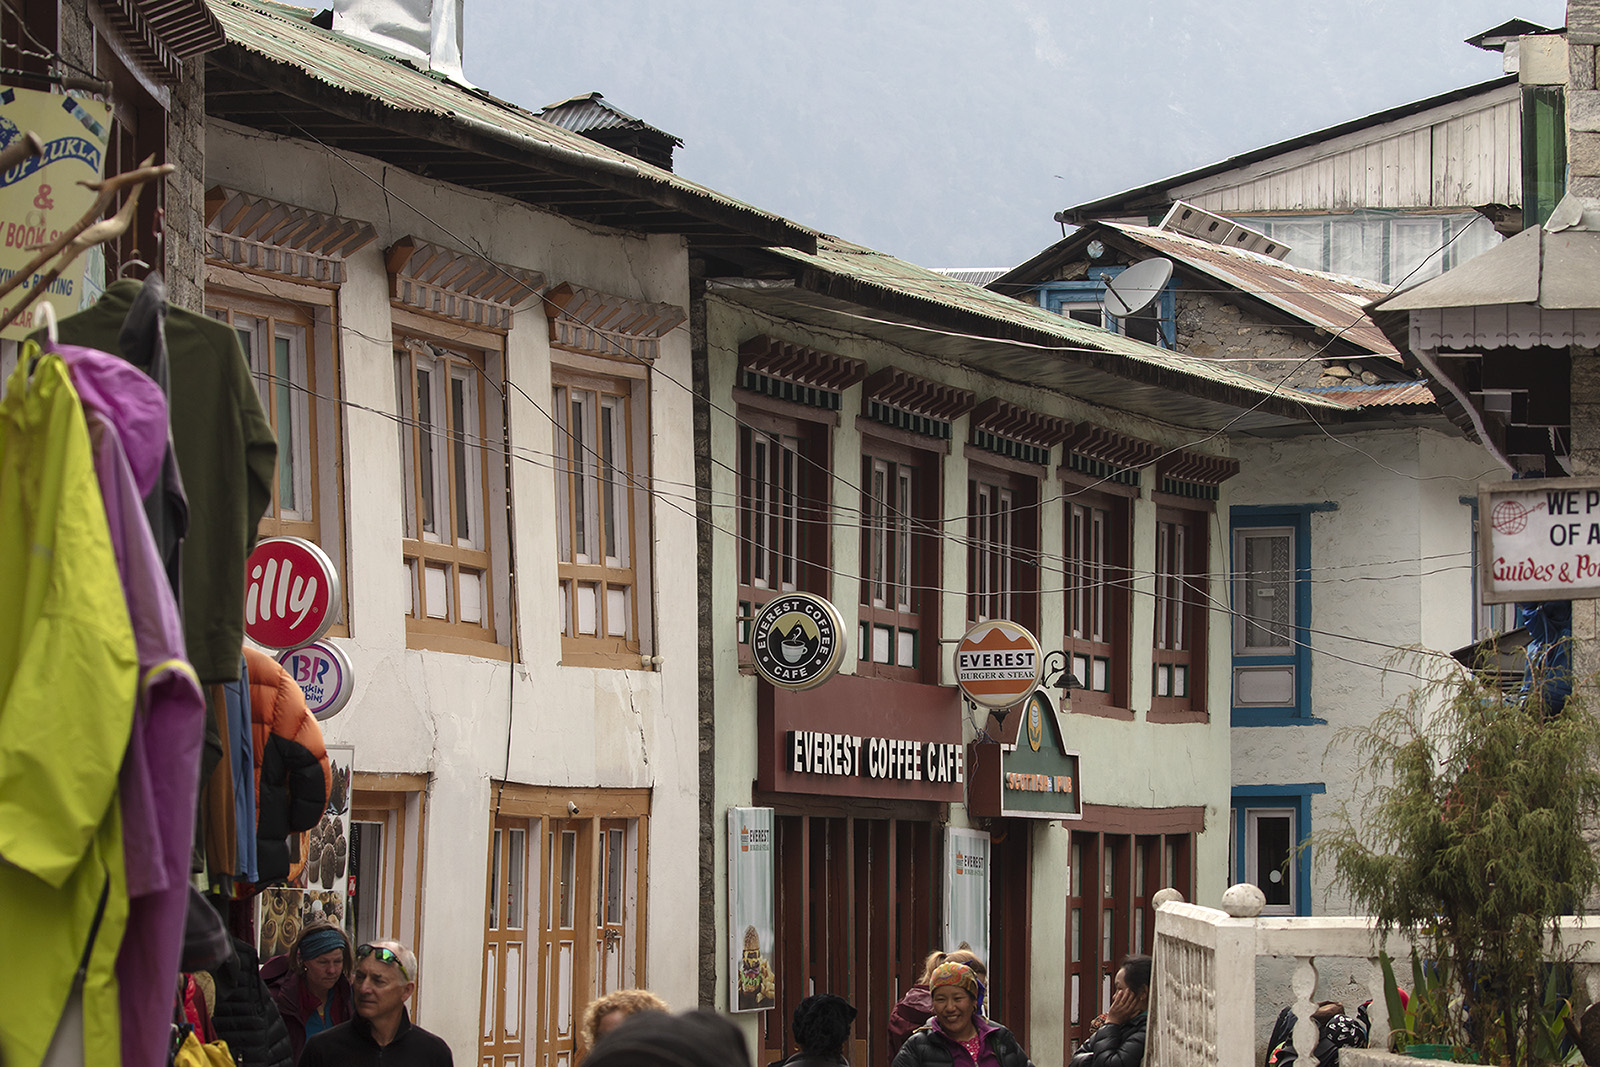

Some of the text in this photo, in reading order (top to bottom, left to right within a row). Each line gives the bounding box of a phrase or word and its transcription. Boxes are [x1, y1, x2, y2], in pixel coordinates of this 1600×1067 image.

[38, 139, 99, 169] LUKLA
[33, 184, 54, 210] &
[1546, 490, 1580, 515] WE
[1550, 523, 1581, 546] OF
[1492, 557, 1555, 582] Guides
[1558, 562, 1574, 584] &
[246, 558, 318, 630] illy
[757, 601, 830, 655] EVEREST COFFEE
[293, 655, 329, 684] BR
[774, 666, 808, 679] CAFE
[960, 653, 1035, 667] EVEREST
[961, 672, 996, 680] BURGER
[998, 671, 1005, 679] &
[299, 683, 323, 694] askin
[305, 692, 323, 704] bins
[793, 730, 963, 783] EVEREST COFFEE CAFE
[1007, 772, 1073, 793] SCOTTISH PUB
